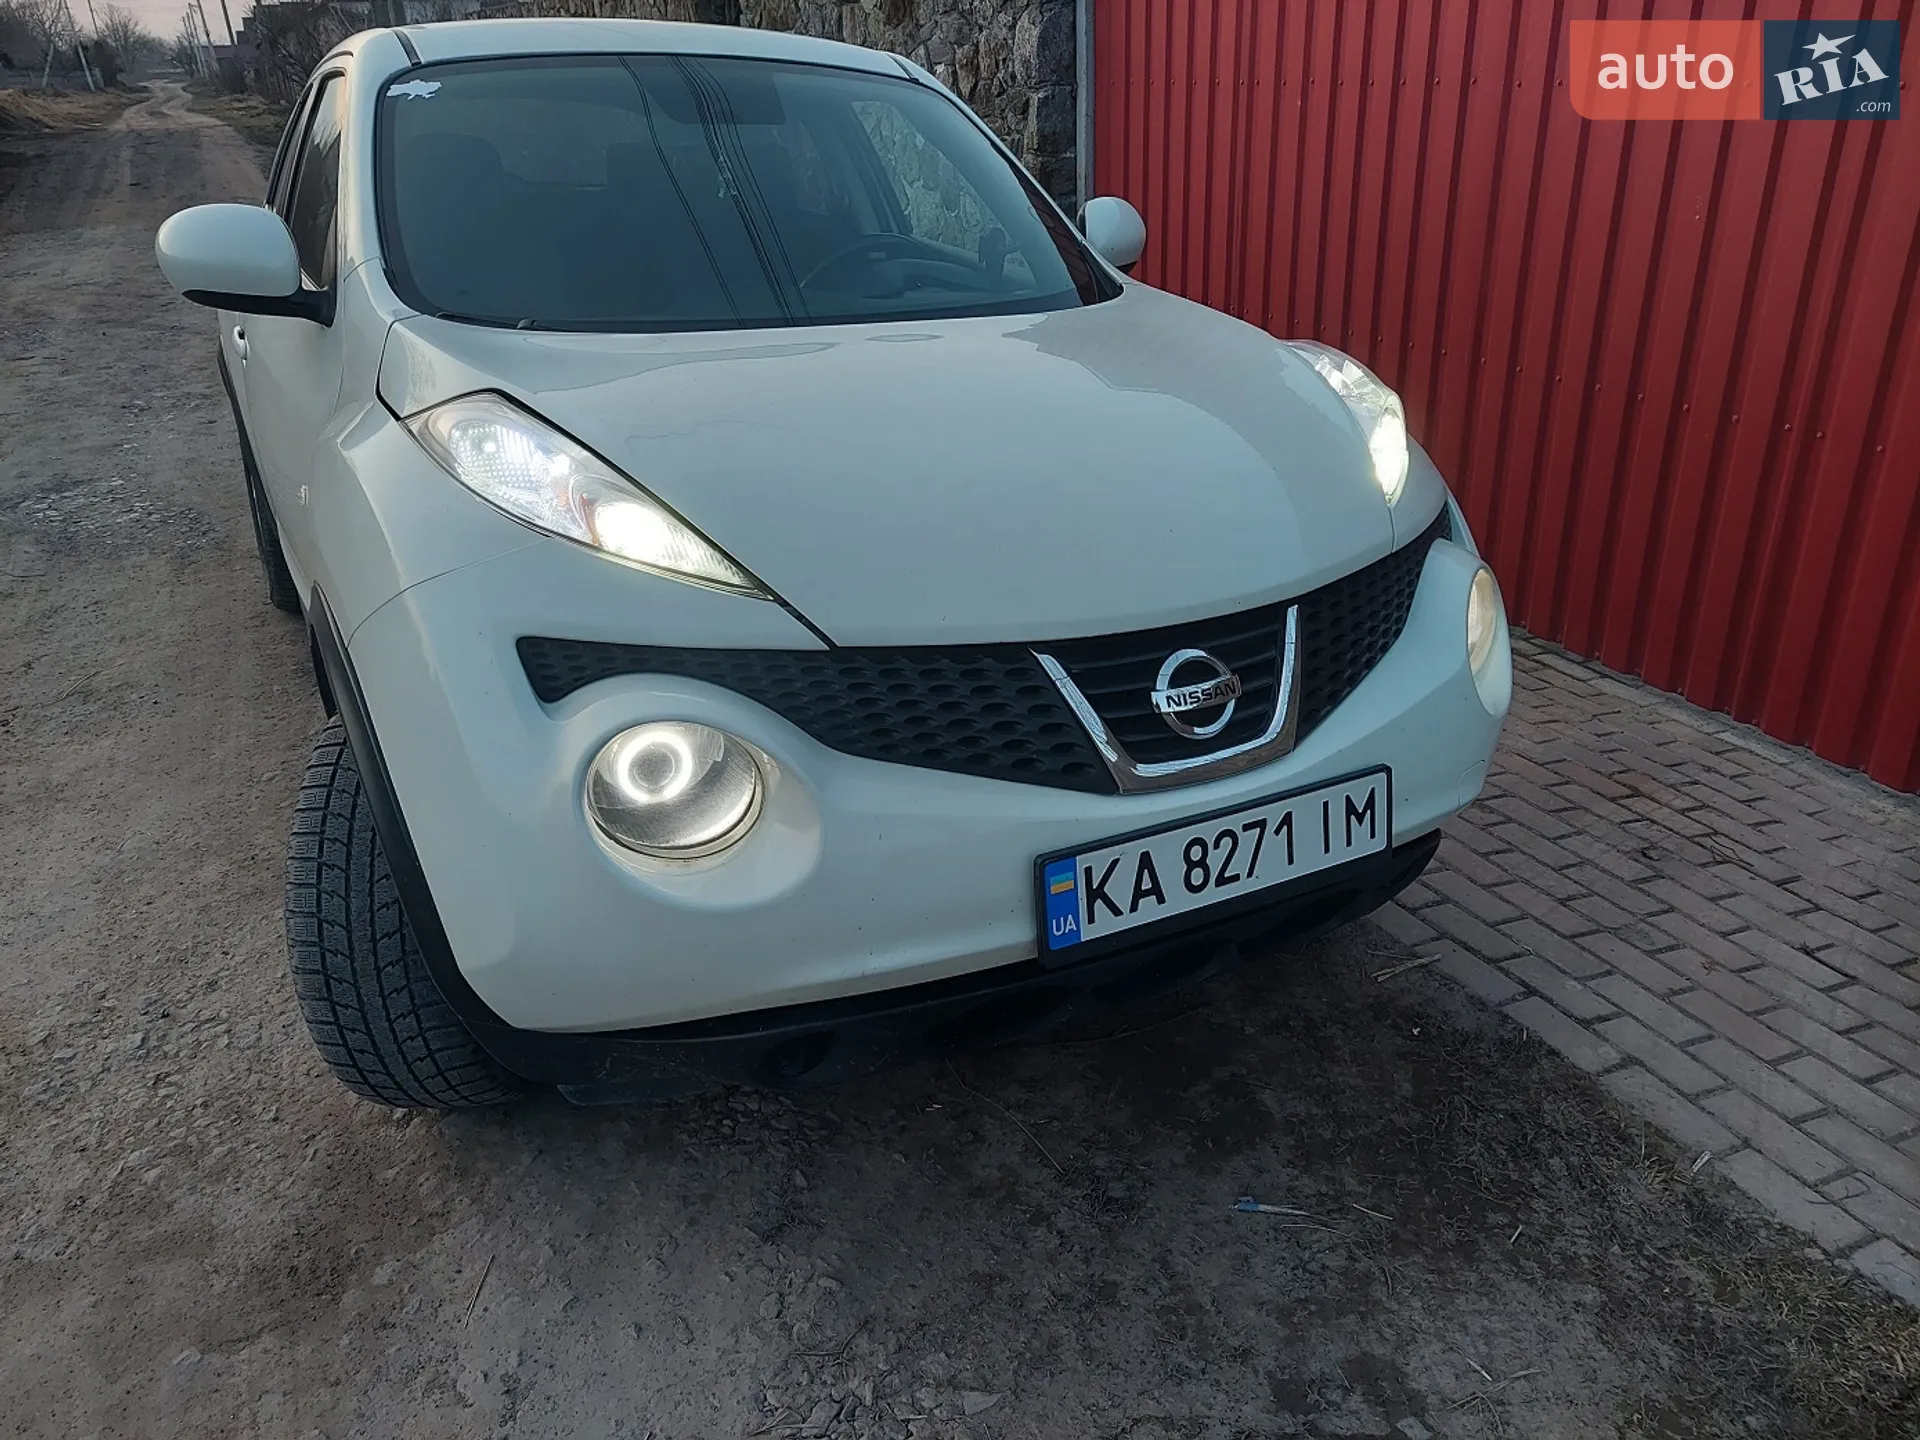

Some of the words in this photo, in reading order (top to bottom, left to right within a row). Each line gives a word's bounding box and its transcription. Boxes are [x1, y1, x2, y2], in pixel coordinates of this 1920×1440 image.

[1165, 681, 1237, 708] NISSAN
[1084, 850, 1166, 925] KA
[1183, 810, 1295, 894] 8271
[1052, 913, 1077, 937] UA
